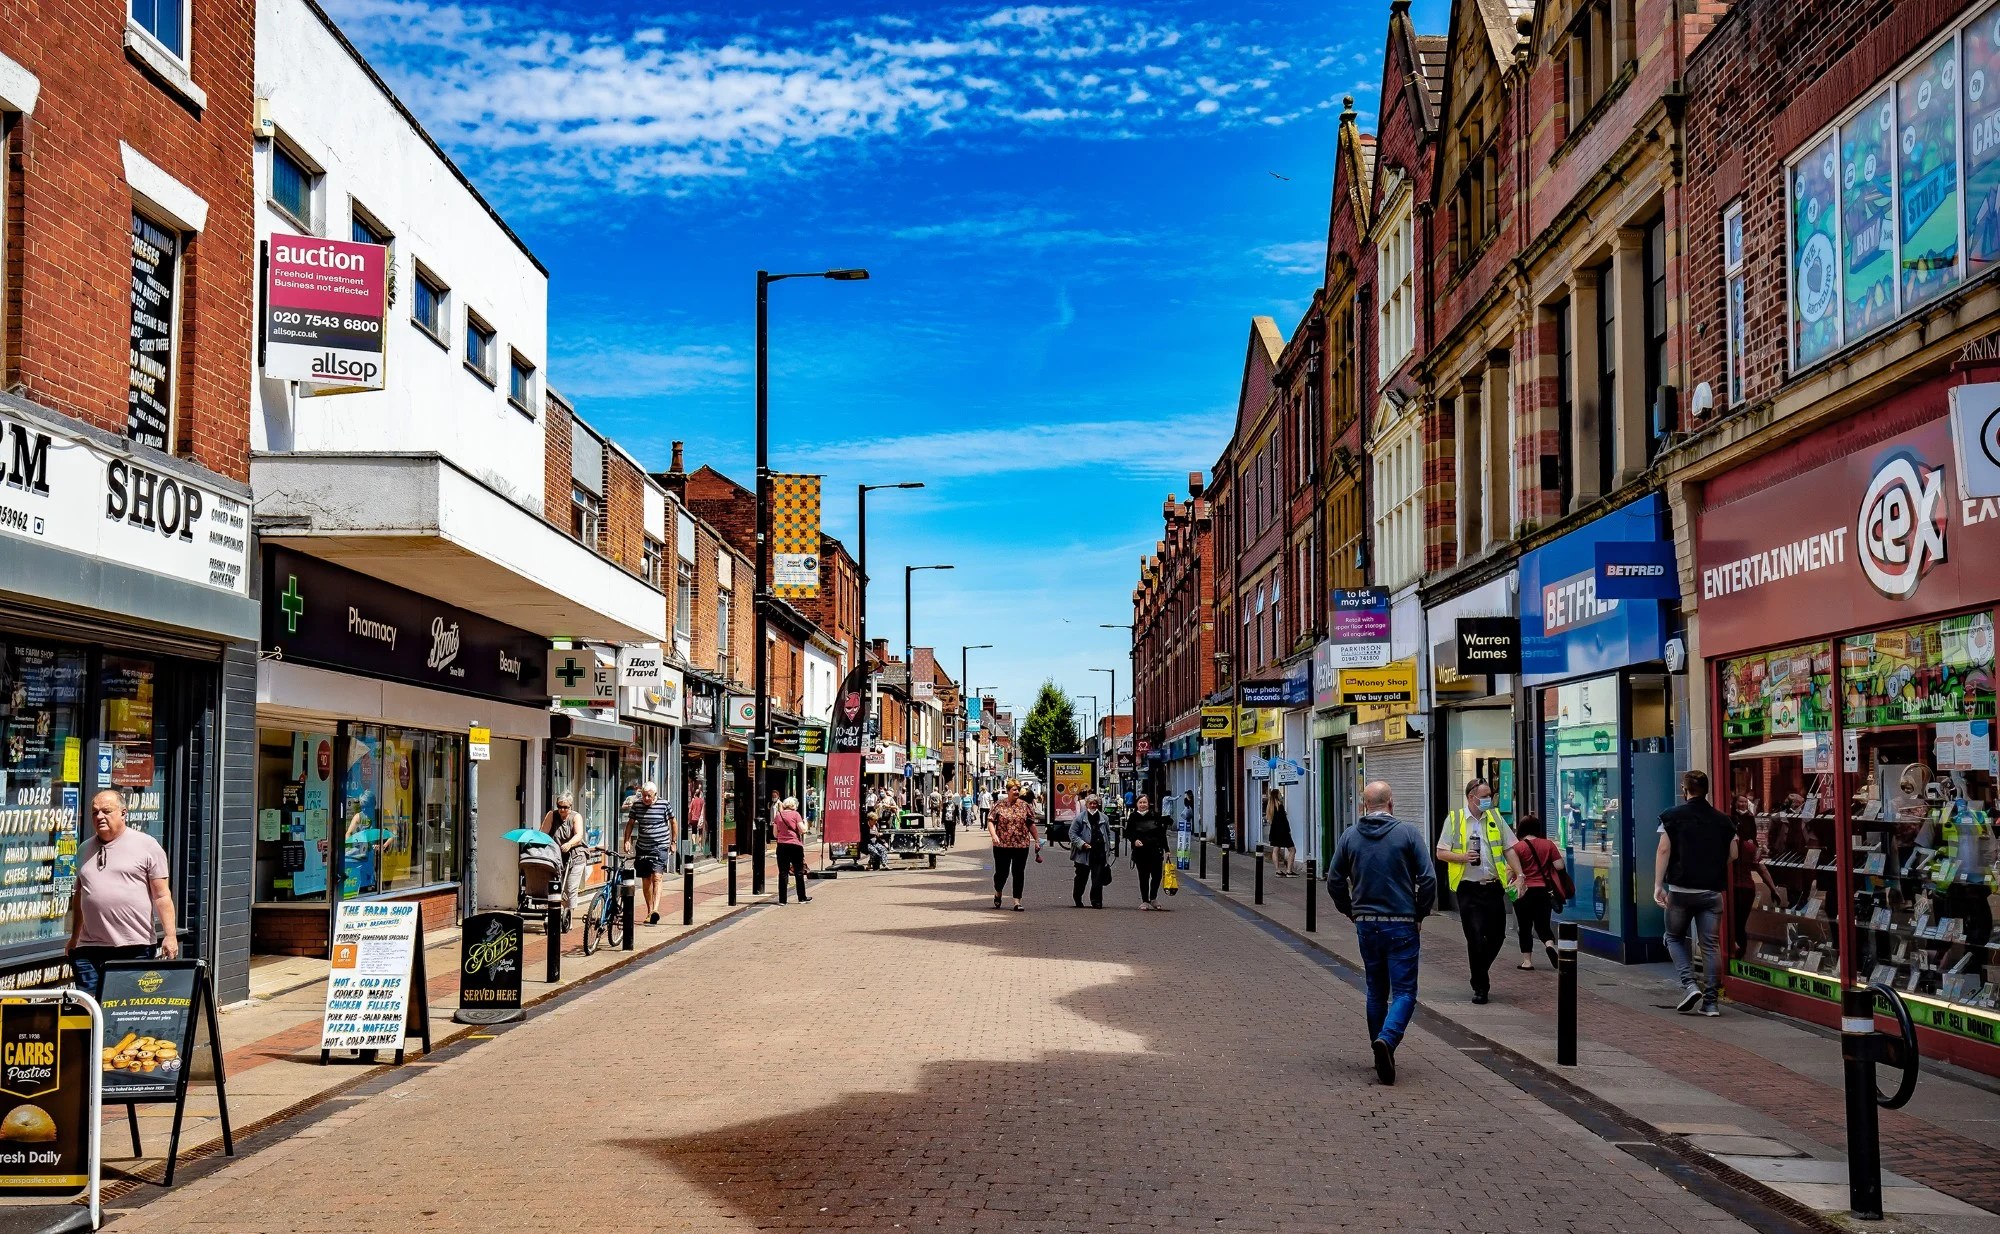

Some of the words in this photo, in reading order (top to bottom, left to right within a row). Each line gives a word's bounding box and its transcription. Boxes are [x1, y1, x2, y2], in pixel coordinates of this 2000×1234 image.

[1908, 176, 1939, 225] STUFF
[1856, 224, 1877, 257] BUY
[275, 246, 366, 272] auction
[274, 268, 314, 280] Freehold
[316, 274, 365, 286] investment
[274, 280, 315, 291] Business
[316, 284, 332, 292] not
[334, 286, 370, 296] affected
[273, 312, 301, 325] 020
[304, 314, 340, 329] 7543
[344, 319, 380, 333] 6800
[273, 327, 318, 340] allsop.co.uk
[140, 354, 166, 382] WINNING
[312, 352, 378, 382] allsop
[106, 458, 203, 544] SHOP
[1606, 564, 1664, 577] BETFRED
[1703, 526, 1848, 600] ENTERTAINMENT
[348, 606, 397, 652] Pharmacy
[427, 616, 460, 672] Boots
[1463, 634, 1510, 646] Warren
[14, 647, 25, 656] THE
[25, 648, 40, 658] FARM
[40, 650, 54, 660] SHOP
[1466, 648, 1508, 660] James
[499, 649, 521, 681] Beauty
[629, 658, 656, 669] Hays
[626, 668, 658, 678] Travel
[1387, 678, 1408, 687] Shop
[834, 776, 854, 786] MAKE
[18, 787, 51, 806] ORDERS
[836, 788, 851, 798] THE
[140, 792, 160, 810] BARM
[829, 800, 856, 811] SWITCH
[5, 847, 28, 864] AWARD
[31, 846, 59, 862] WINNING
[4, 867, 28, 886] CHEESE
[343, 906, 360, 916] THE
[363, 906, 388, 916] FARM
[391, 906, 413, 916] SHOP
[464, 930, 517, 974] GOLD'S
[16, 968, 42, 989] BOARDS
[44, 965, 61, 983] MADE
[137, 977, 163, 988] Taylors
[334, 978, 350, 988] HOT
[360, 978, 380, 988] COLD
[382, 978, 401, 988] PIES
[334, 989, 363, 999] COOKED
[367, 989, 393, 999] MEATS
[464, 988, 494, 1001] SERVED
[496, 990, 518, 1001] HERE
[1788, 976, 1798, 988] BUY
[1800, 977, 1810, 993] SELL
[1812, 980, 1832, 998] DONATE
[102, 1000, 119, 1009] TRY
[130, 997, 166, 1006] TAYLORS
[168, 997, 191, 1006] HERE
[329, 1000, 362, 1010] CHICKEN
[367, 1000, 400, 1010] FILLETS
[328, 1023, 355, 1032] PIZZA
[362, 1023, 399, 1032] WAFFLES
[1932, 1010, 1945, 1026] BUY
[1948, 1012, 1964, 1032] SELL
[1967, 1016, 1994, 1040] DONATE
[324, 1037, 340, 1047] HOT
[346, 1037, 364, 1046] COLD
[366, 1034, 396, 1045] DRINKS
[5, 1042, 54, 1066] CARRS
[8, 1066, 51, 1080] Pasties
[29, 1151, 62, 1166] Daily
